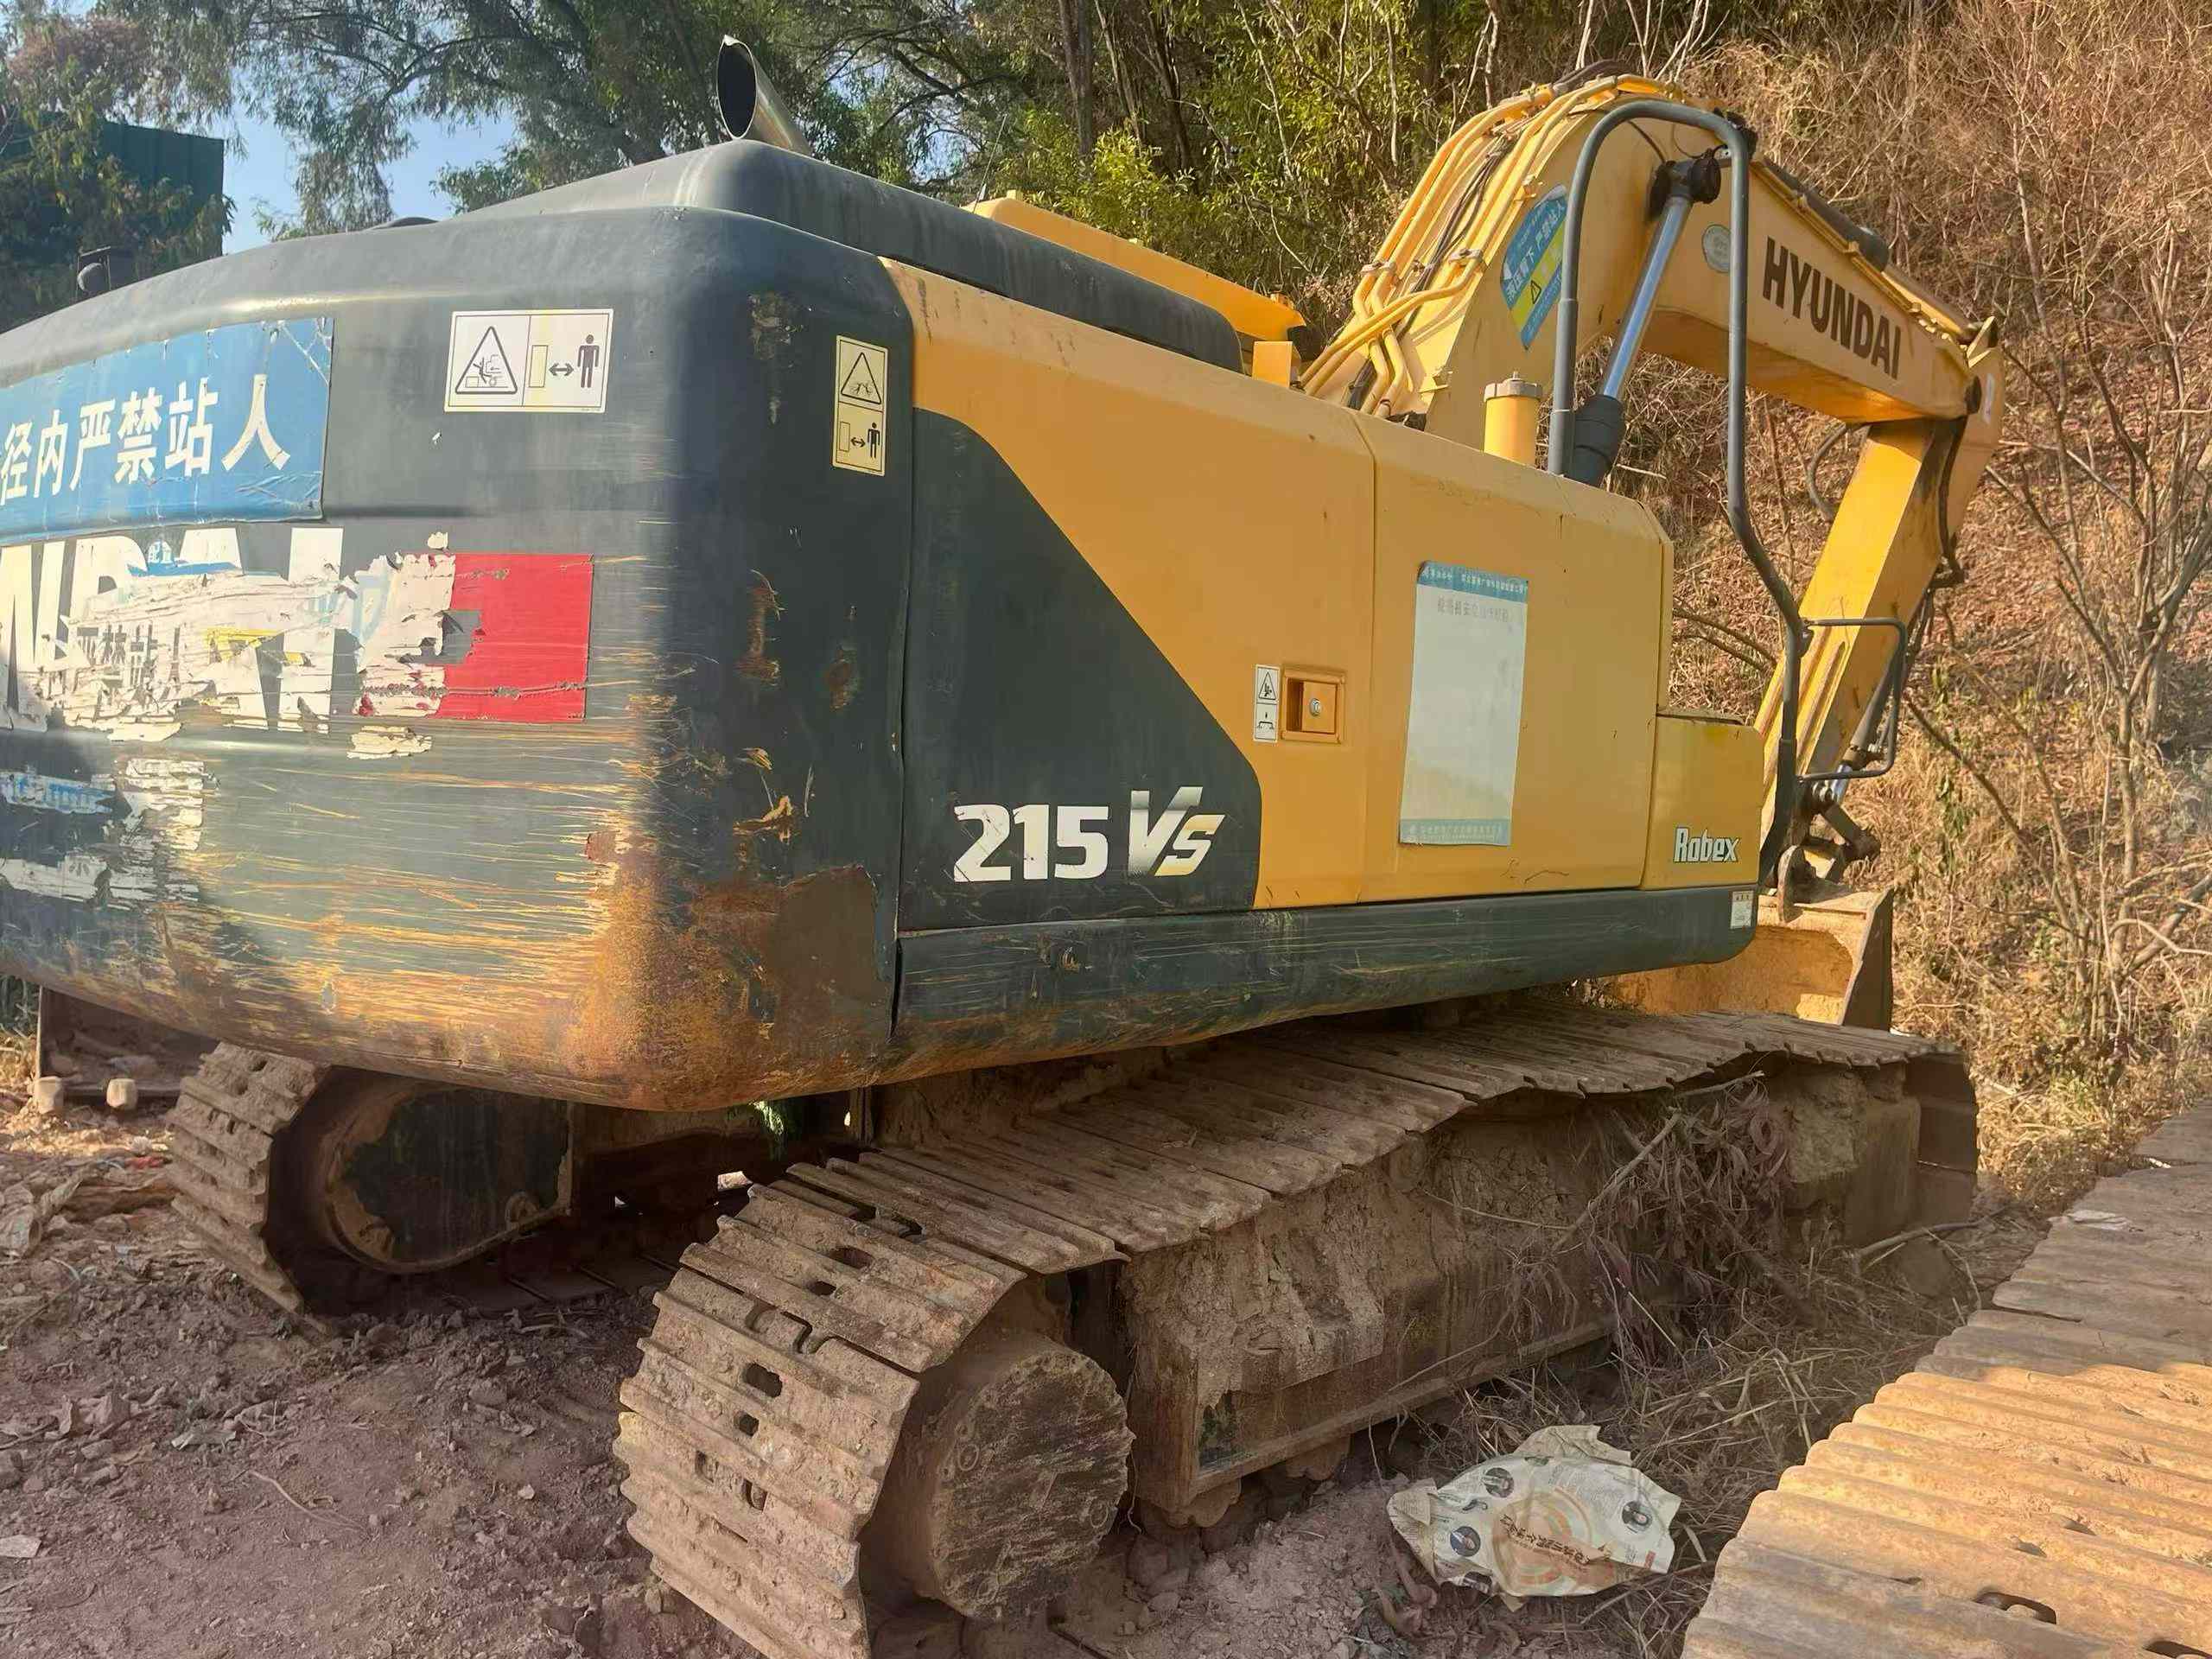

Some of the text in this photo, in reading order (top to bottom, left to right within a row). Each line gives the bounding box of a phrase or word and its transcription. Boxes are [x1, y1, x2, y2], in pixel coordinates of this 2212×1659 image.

[1762, 235, 1901, 380] HYUNDAI
[0, 373, 291, 505] 径内严禁站人
[953, 785, 1226, 882] 215 Vs
[1673, 826, 1742, 862] Robex
